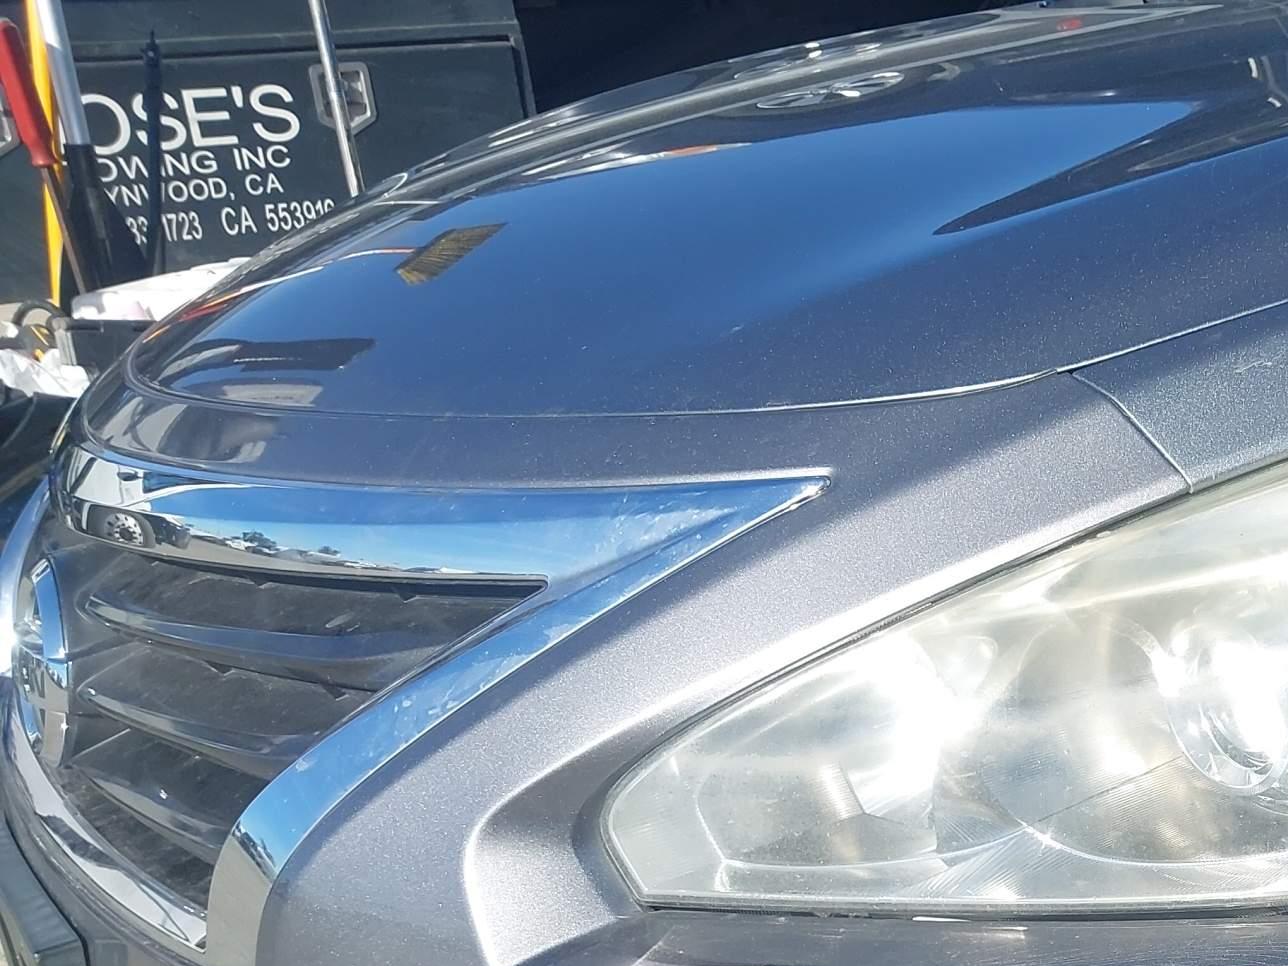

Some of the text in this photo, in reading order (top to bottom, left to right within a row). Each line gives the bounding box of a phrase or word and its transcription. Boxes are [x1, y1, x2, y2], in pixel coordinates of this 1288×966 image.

[59, 84, 300, 155] OSE'S
[233, 145, 291, 171] INC
[245, 173, 284, 195] CA
[221, 206, 257, 235] CA
